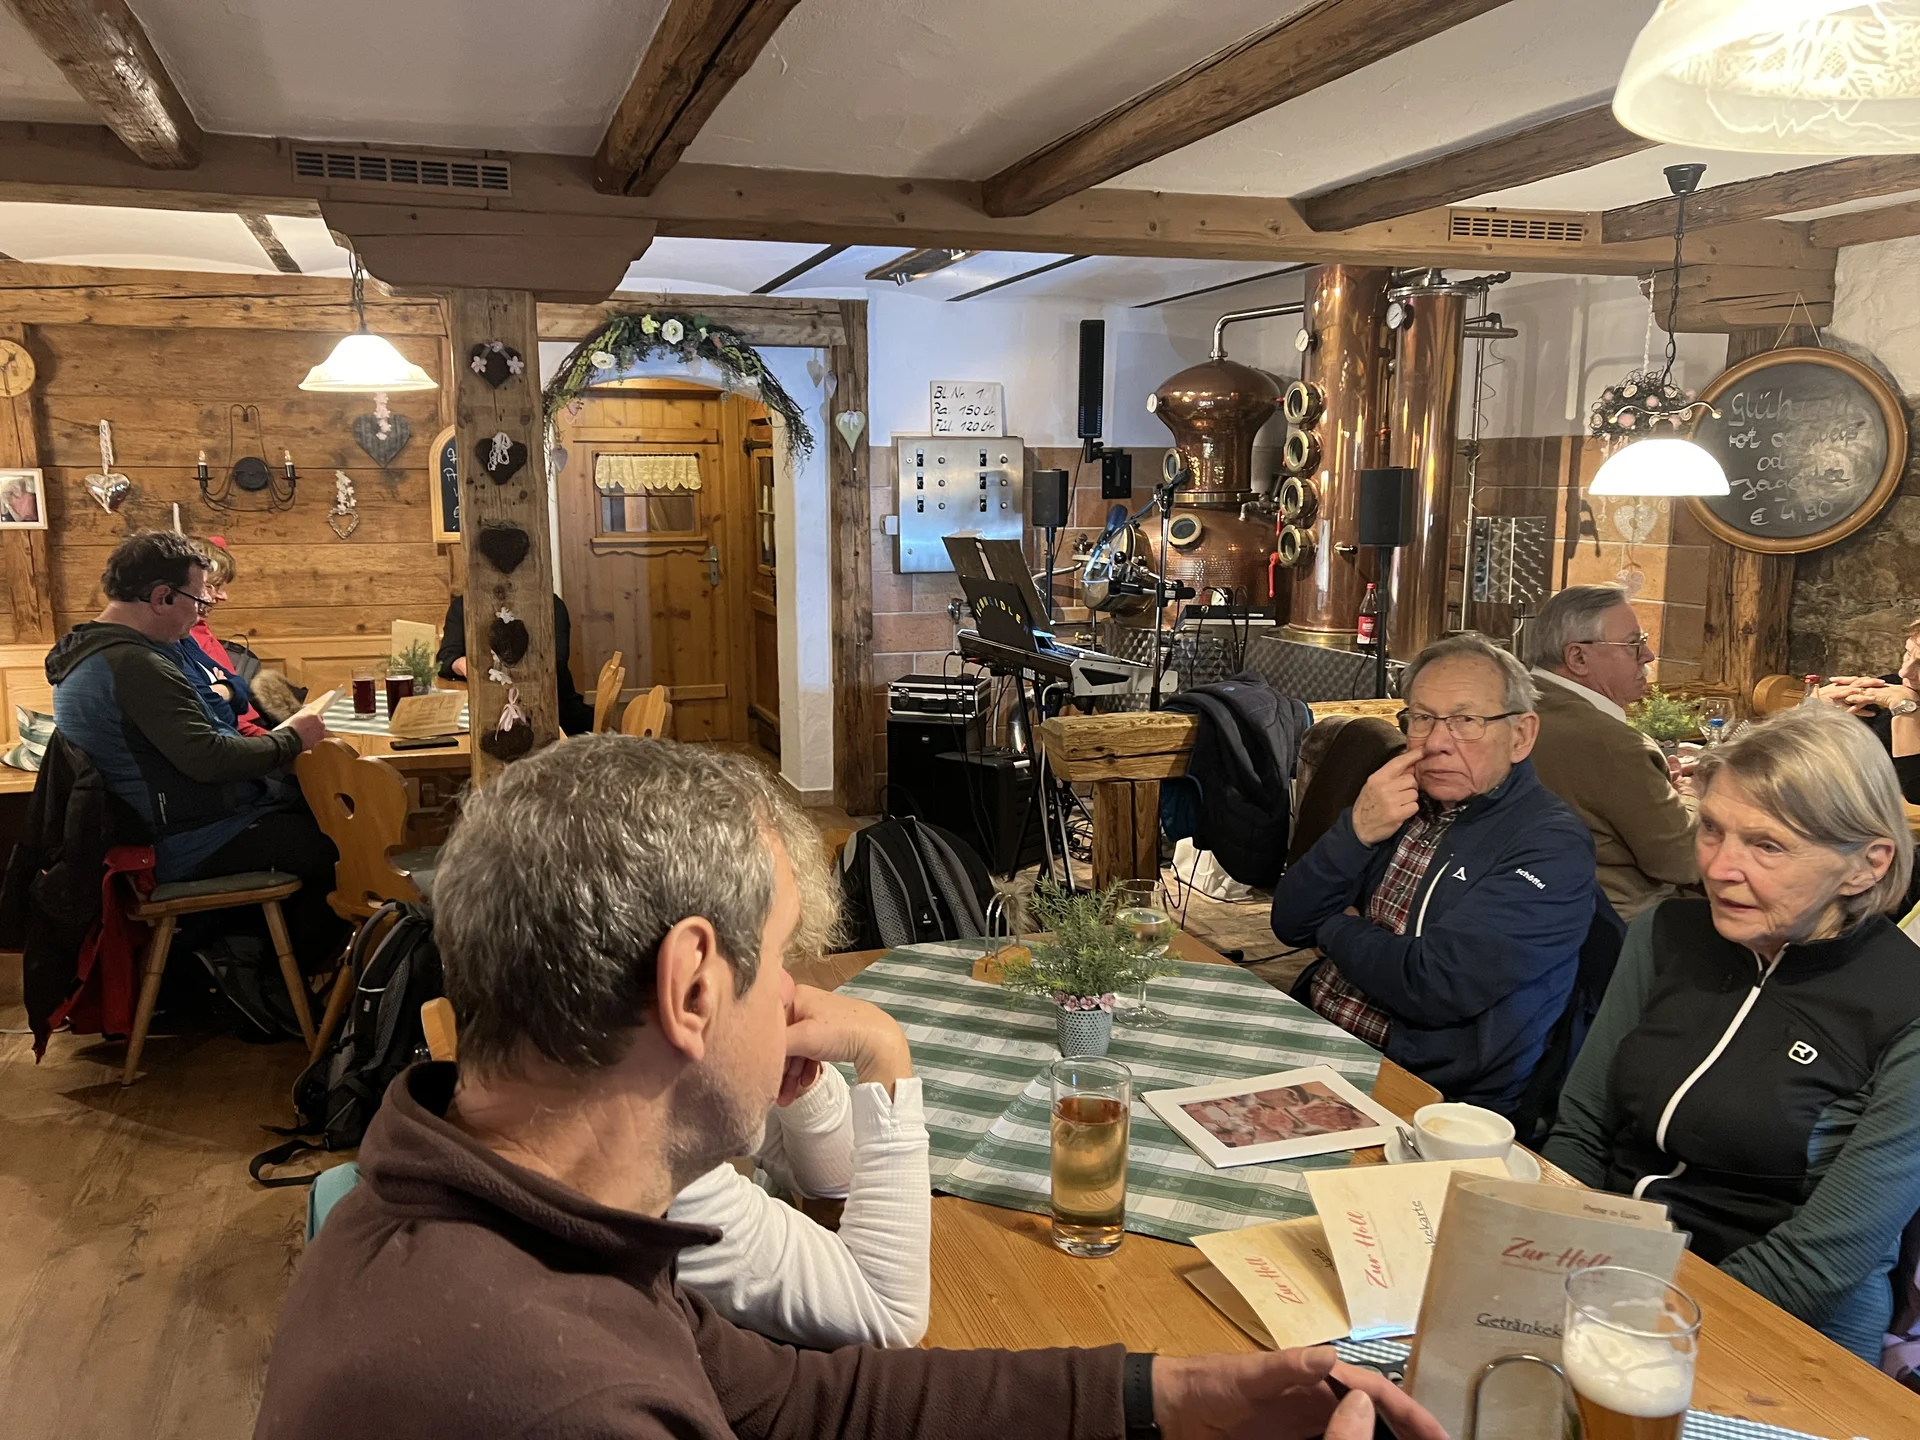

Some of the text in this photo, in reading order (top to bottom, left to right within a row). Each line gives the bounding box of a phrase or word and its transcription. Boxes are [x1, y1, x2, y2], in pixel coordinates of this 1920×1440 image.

[959, 404, 981, 416] 150
[960, 421, 979, 431] 120
[1728, 426, 1761, 449] rot
[1502, 1237, 1550, 1261] Zur
[1364, 1254, 1388, 1289] Zur
[1275, 1282, 1304, 1304] Zur
